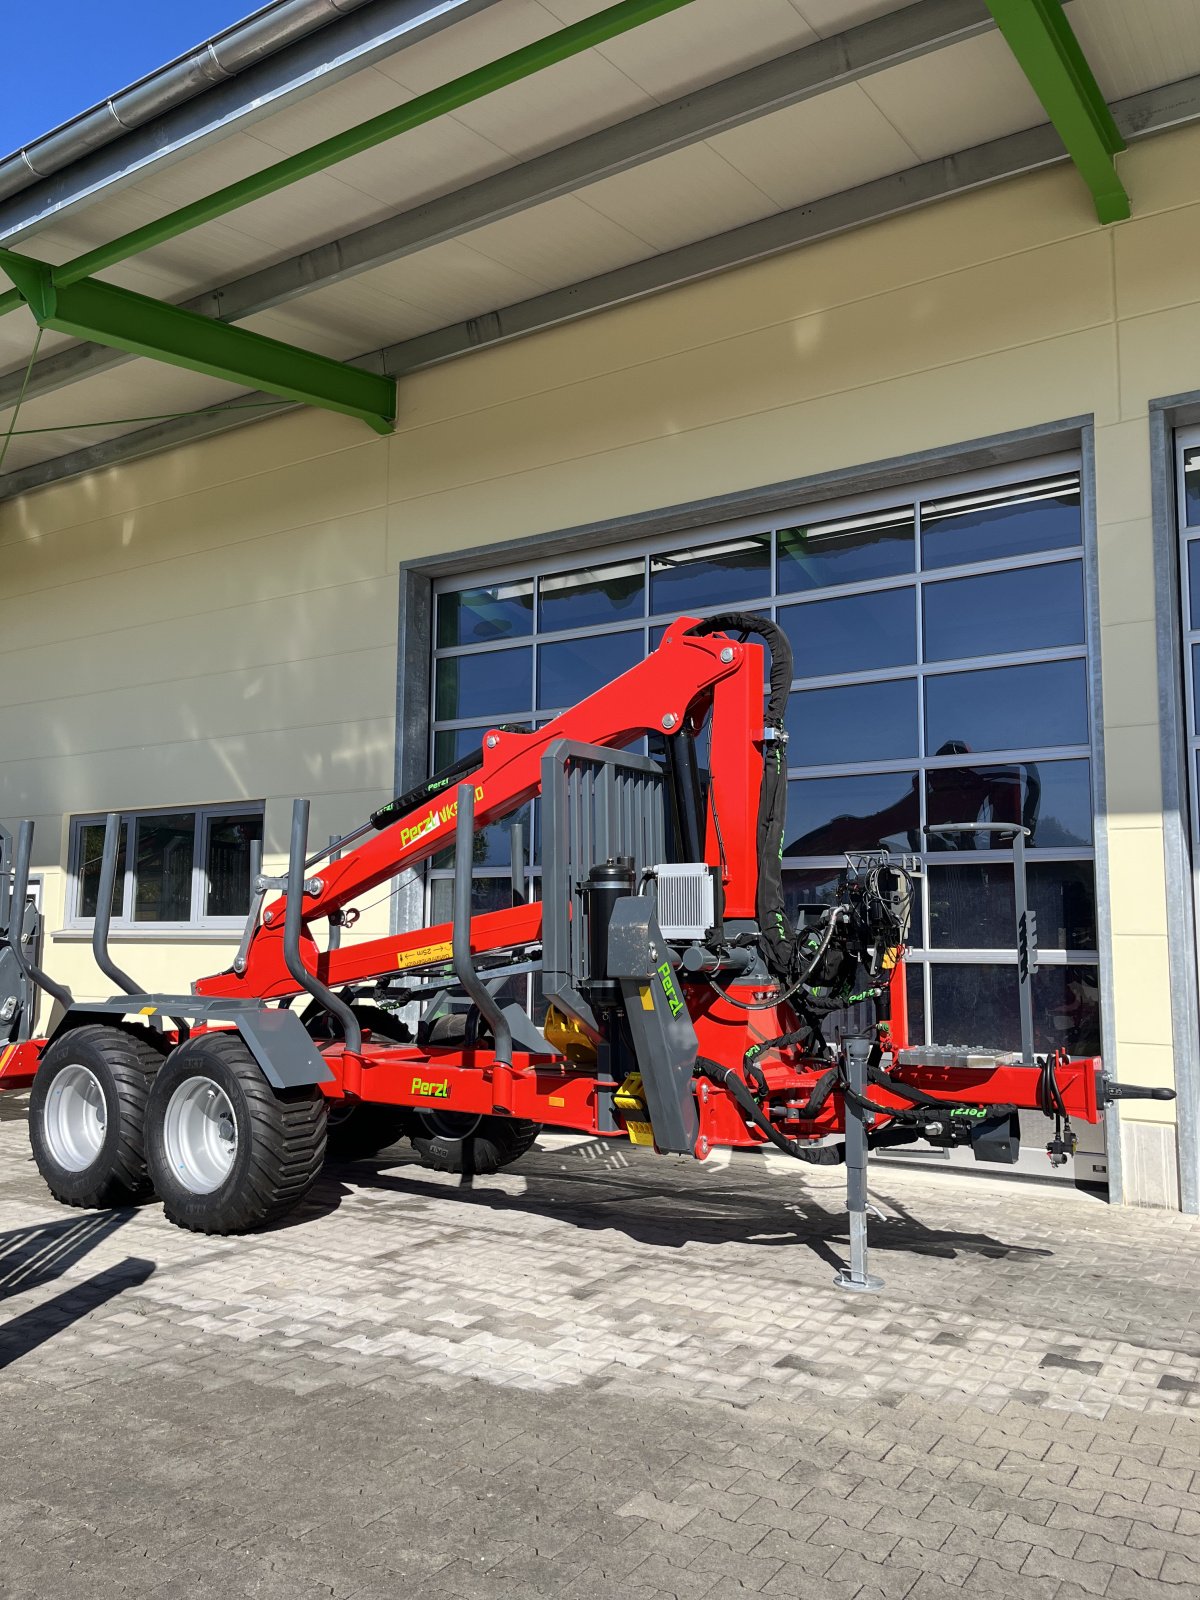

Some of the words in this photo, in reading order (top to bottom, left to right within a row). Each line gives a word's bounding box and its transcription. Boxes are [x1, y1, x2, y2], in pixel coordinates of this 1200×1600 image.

[428, 778, 448, 791] Perzl
[401, 810, 436, 846] Perzl
[416, 948, 432, 956] 25m
[657, 961, 683, 1017] Perzl
[411, 1077, 448, 1097] Perzl
[950, 1108, 987, 1118] Perzl
